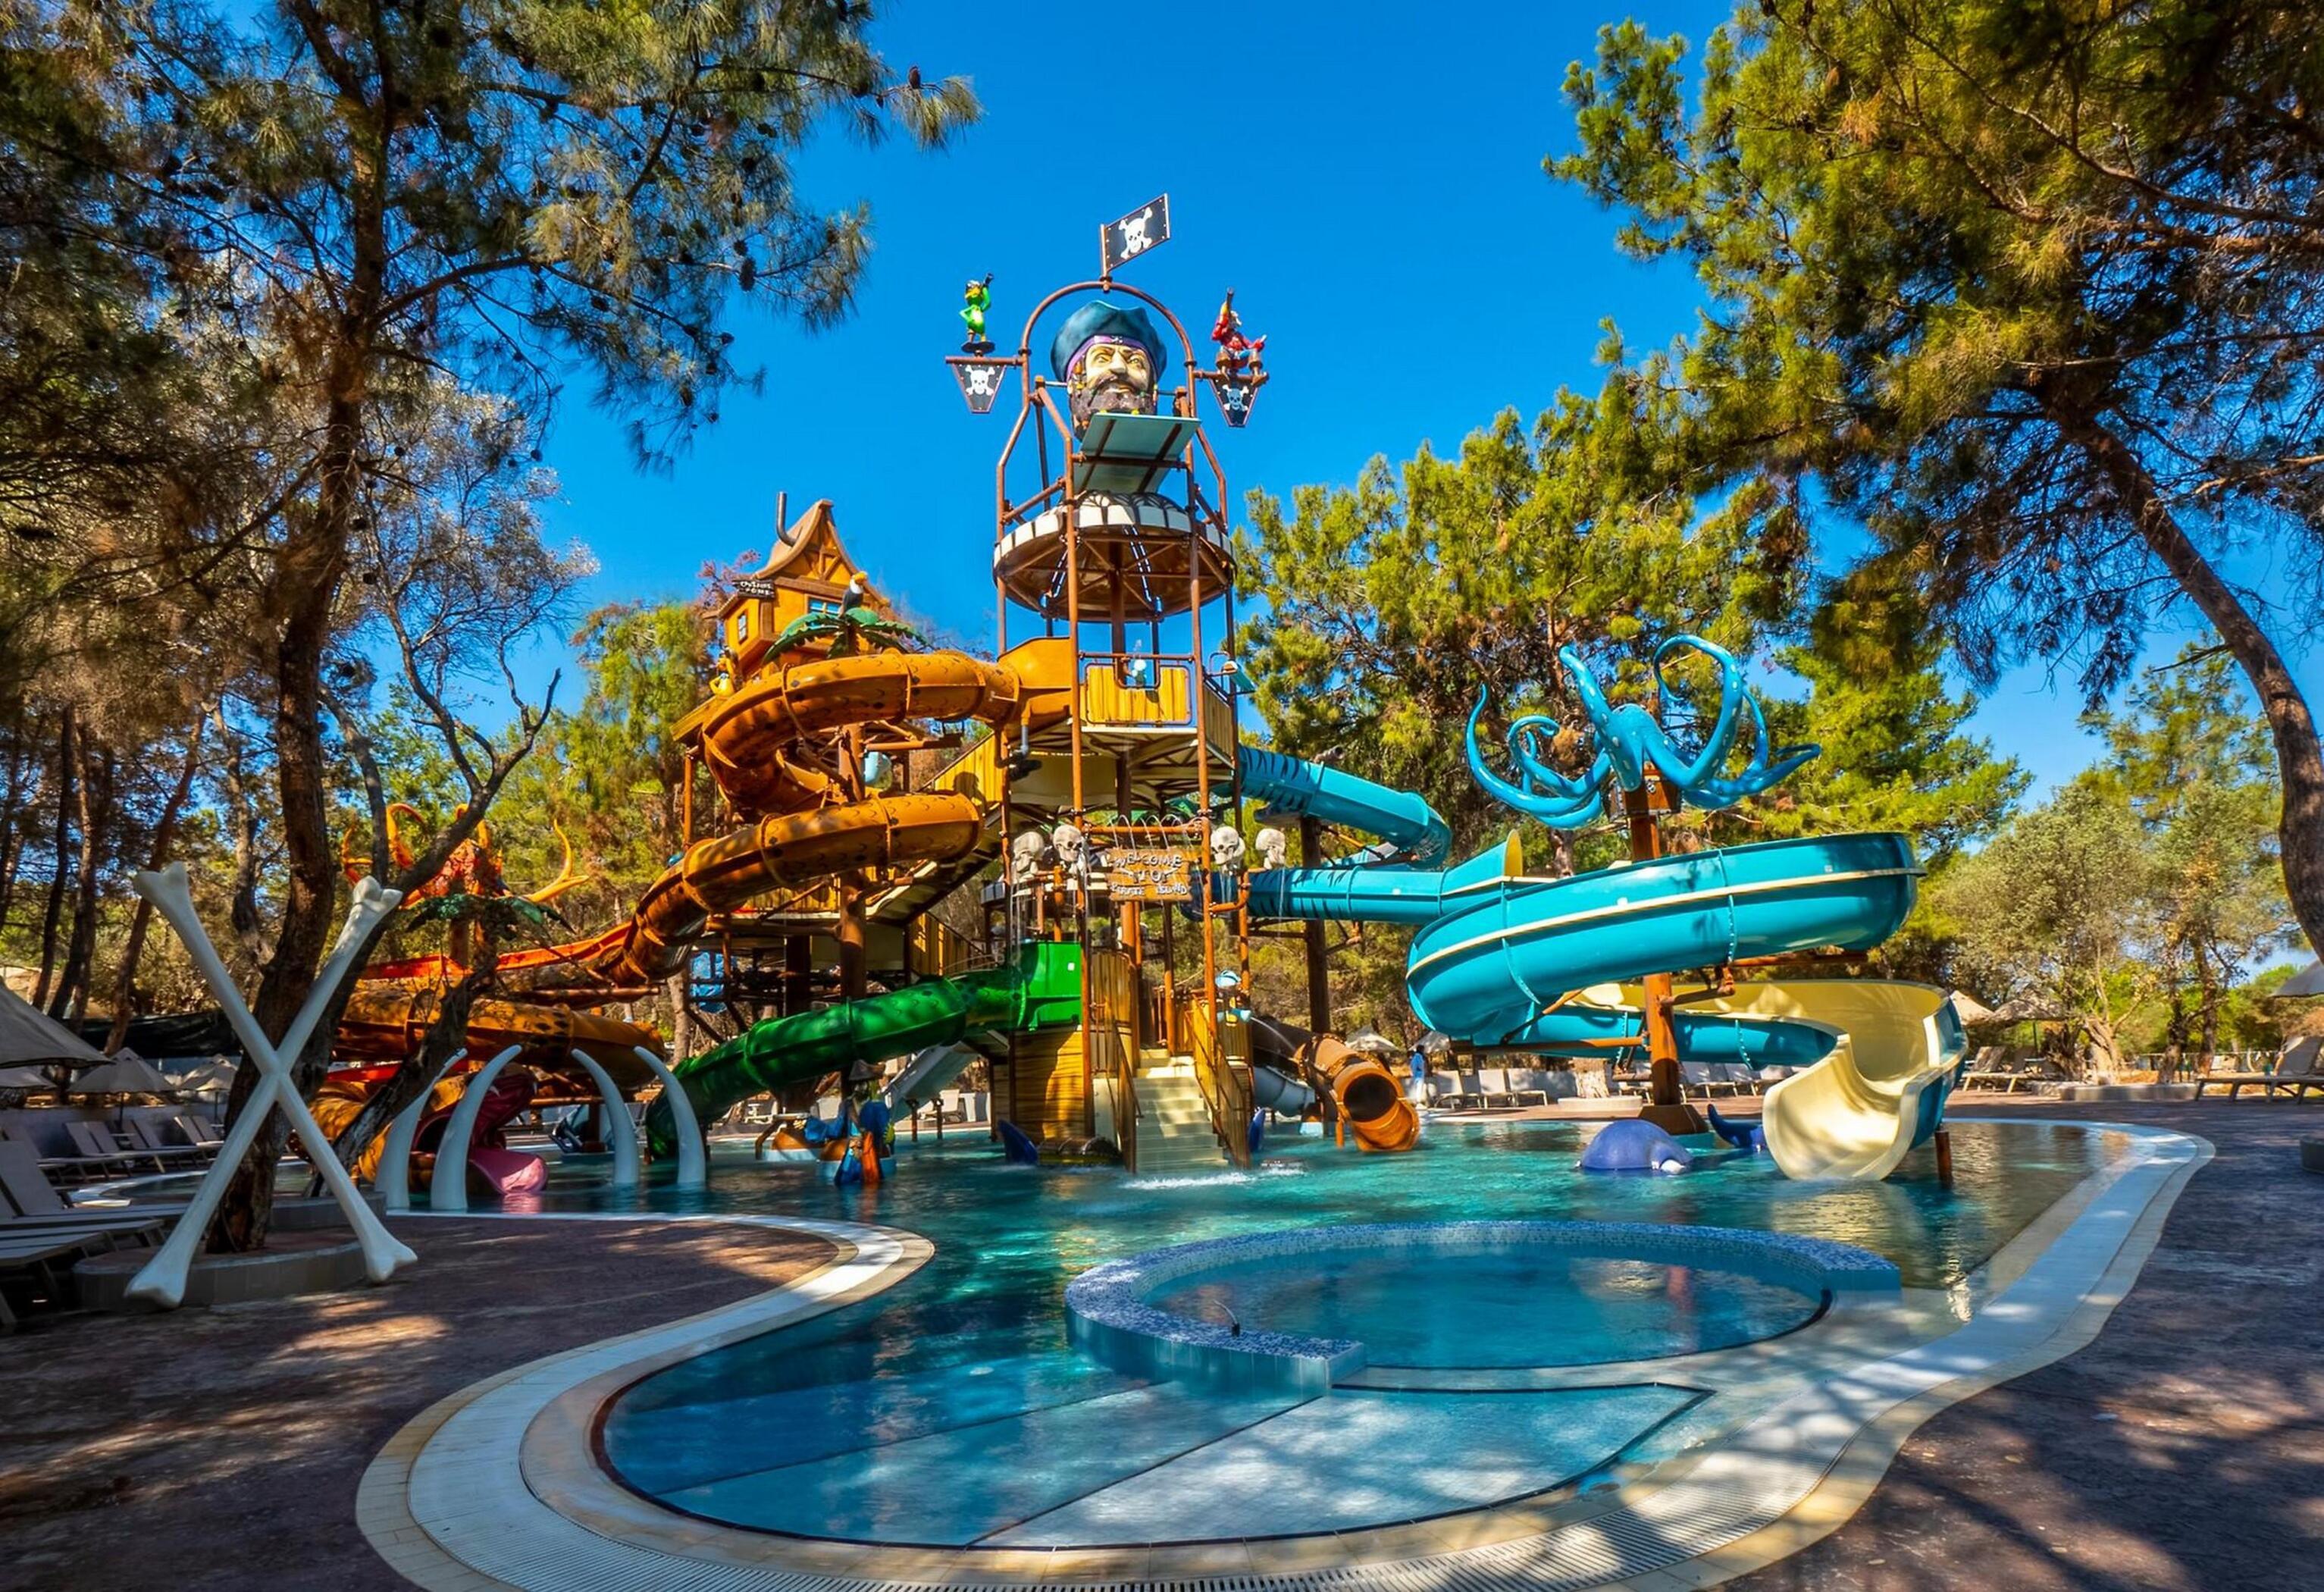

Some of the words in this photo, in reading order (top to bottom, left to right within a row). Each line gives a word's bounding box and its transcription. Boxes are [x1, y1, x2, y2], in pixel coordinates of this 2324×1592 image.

[1114, 852, 1182, 867] WELCOME
[1136, 870, 1162, 882] TO
[1157, 882, 1187, 895] ISLAND
